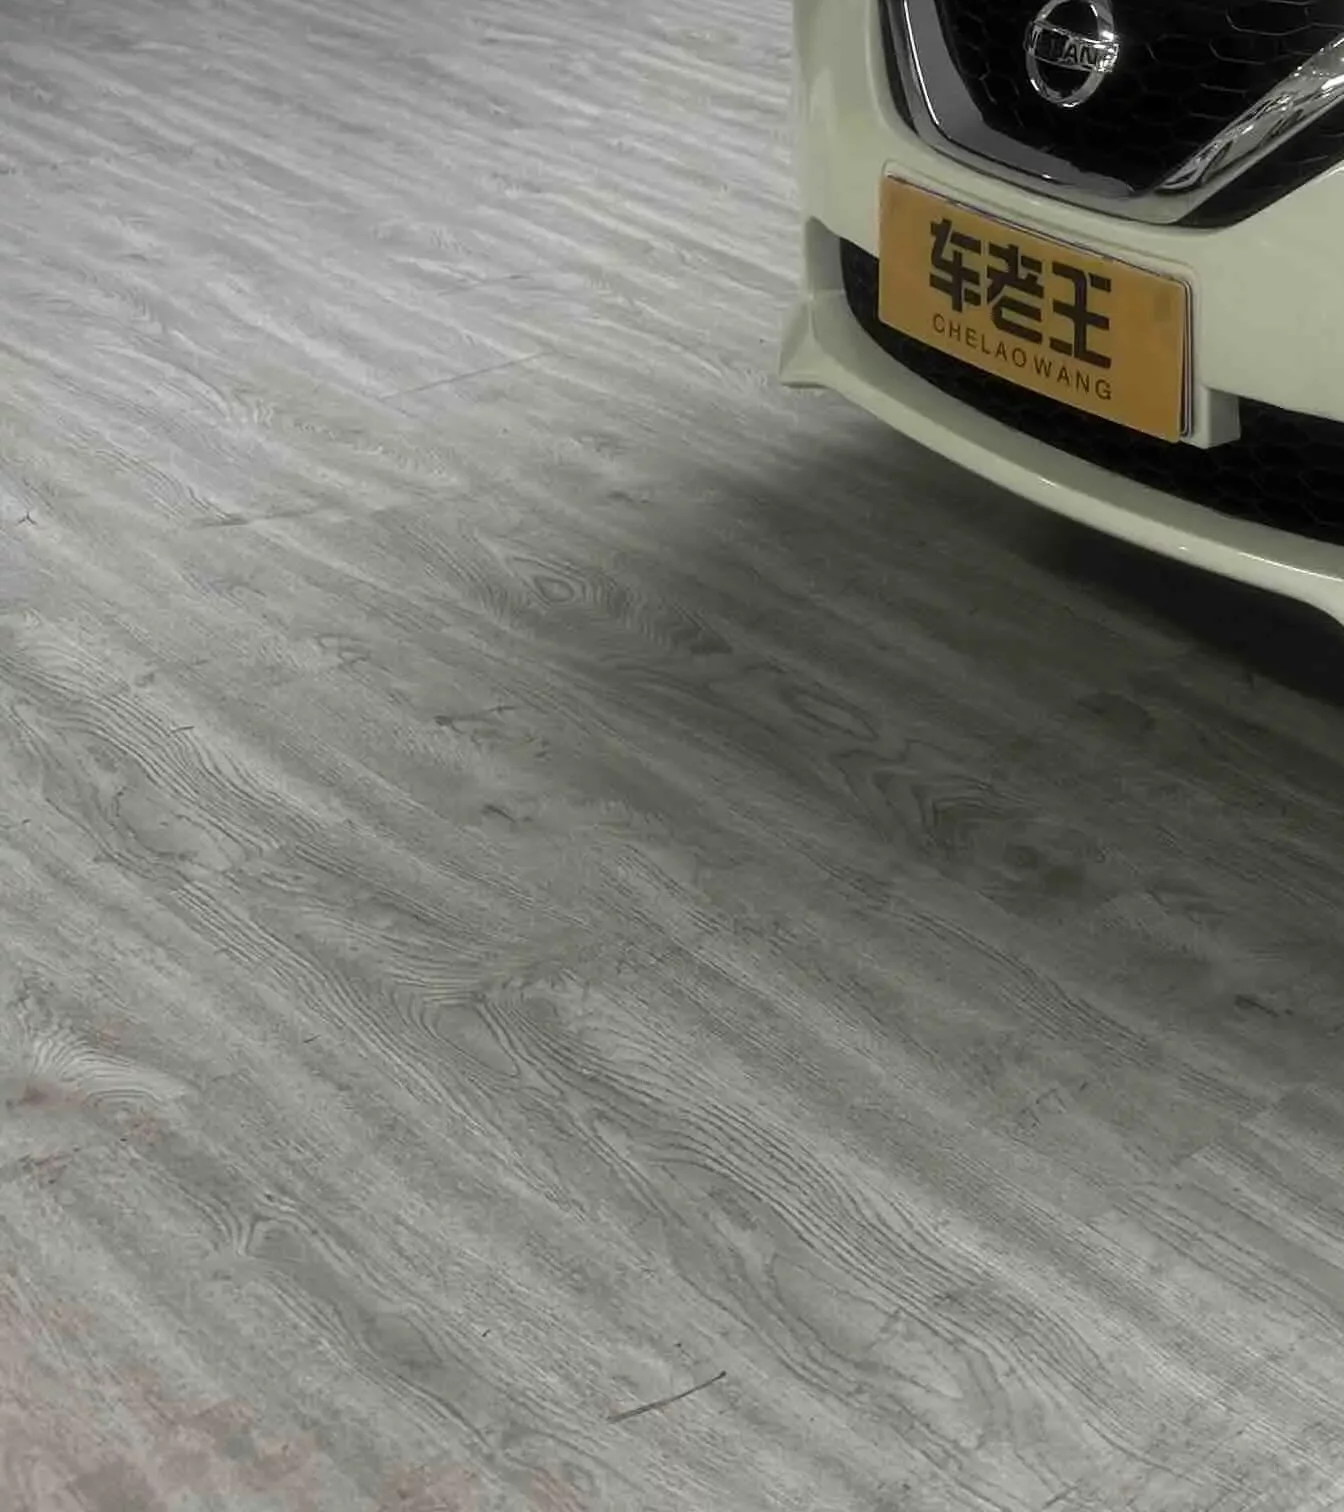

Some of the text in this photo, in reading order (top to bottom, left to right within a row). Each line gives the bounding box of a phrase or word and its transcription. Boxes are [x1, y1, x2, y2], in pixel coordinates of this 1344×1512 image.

[929, 218, 1112, 369] 车老王
[932, 312, 1112, 400] CHELAOWANG
